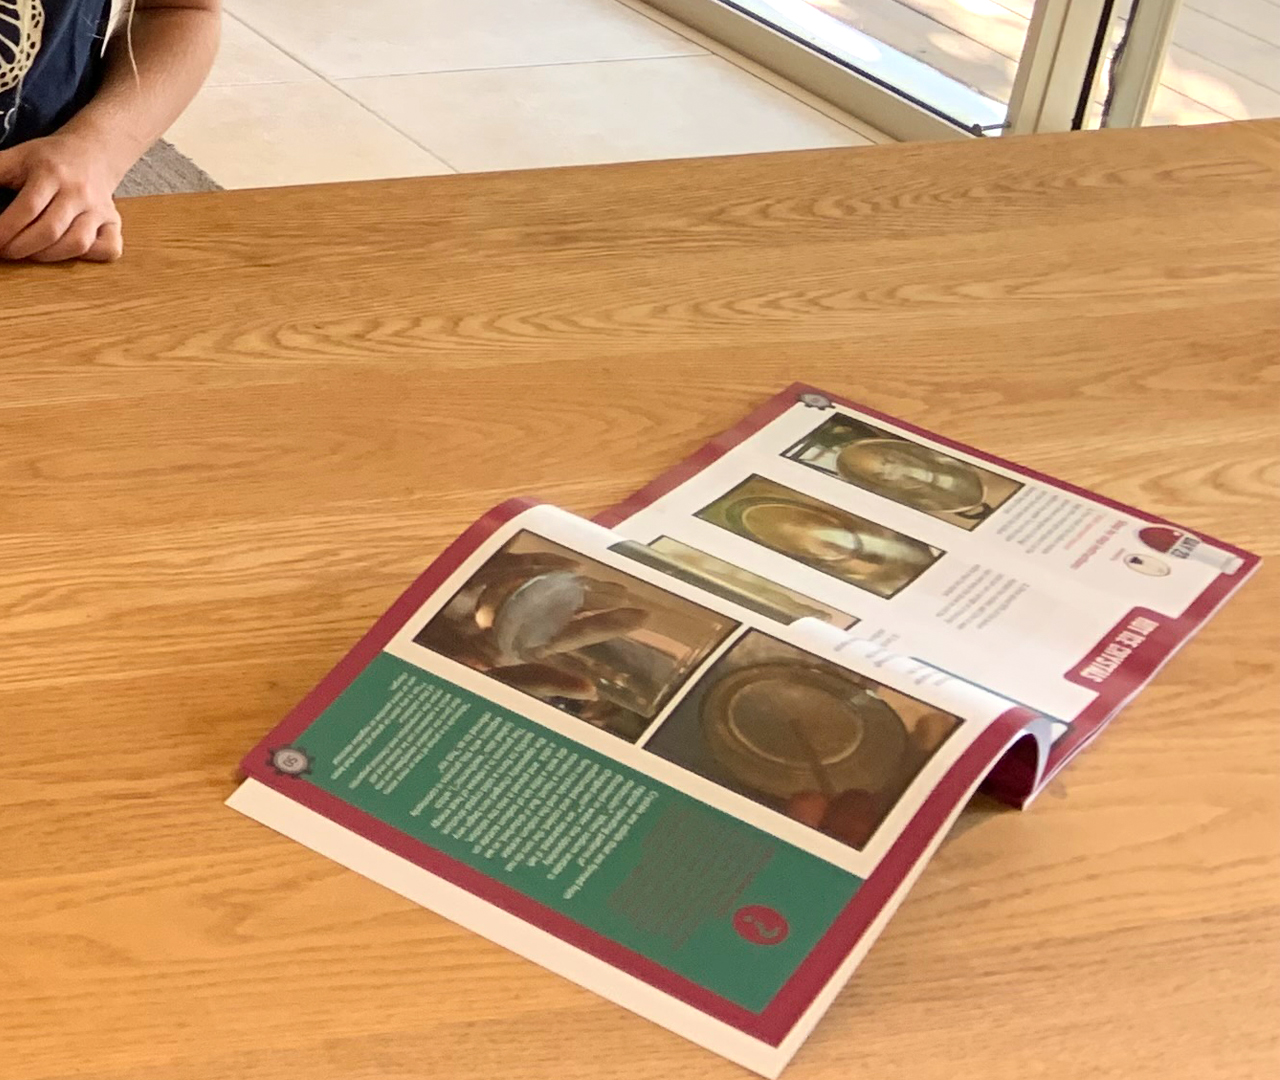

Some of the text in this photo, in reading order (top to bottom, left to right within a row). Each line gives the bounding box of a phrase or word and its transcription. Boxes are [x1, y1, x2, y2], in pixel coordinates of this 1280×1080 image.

[1179, 536, 1200, 551] DAY
[1077, 614, 1160, 685] HOT ICE CRYSTALS
